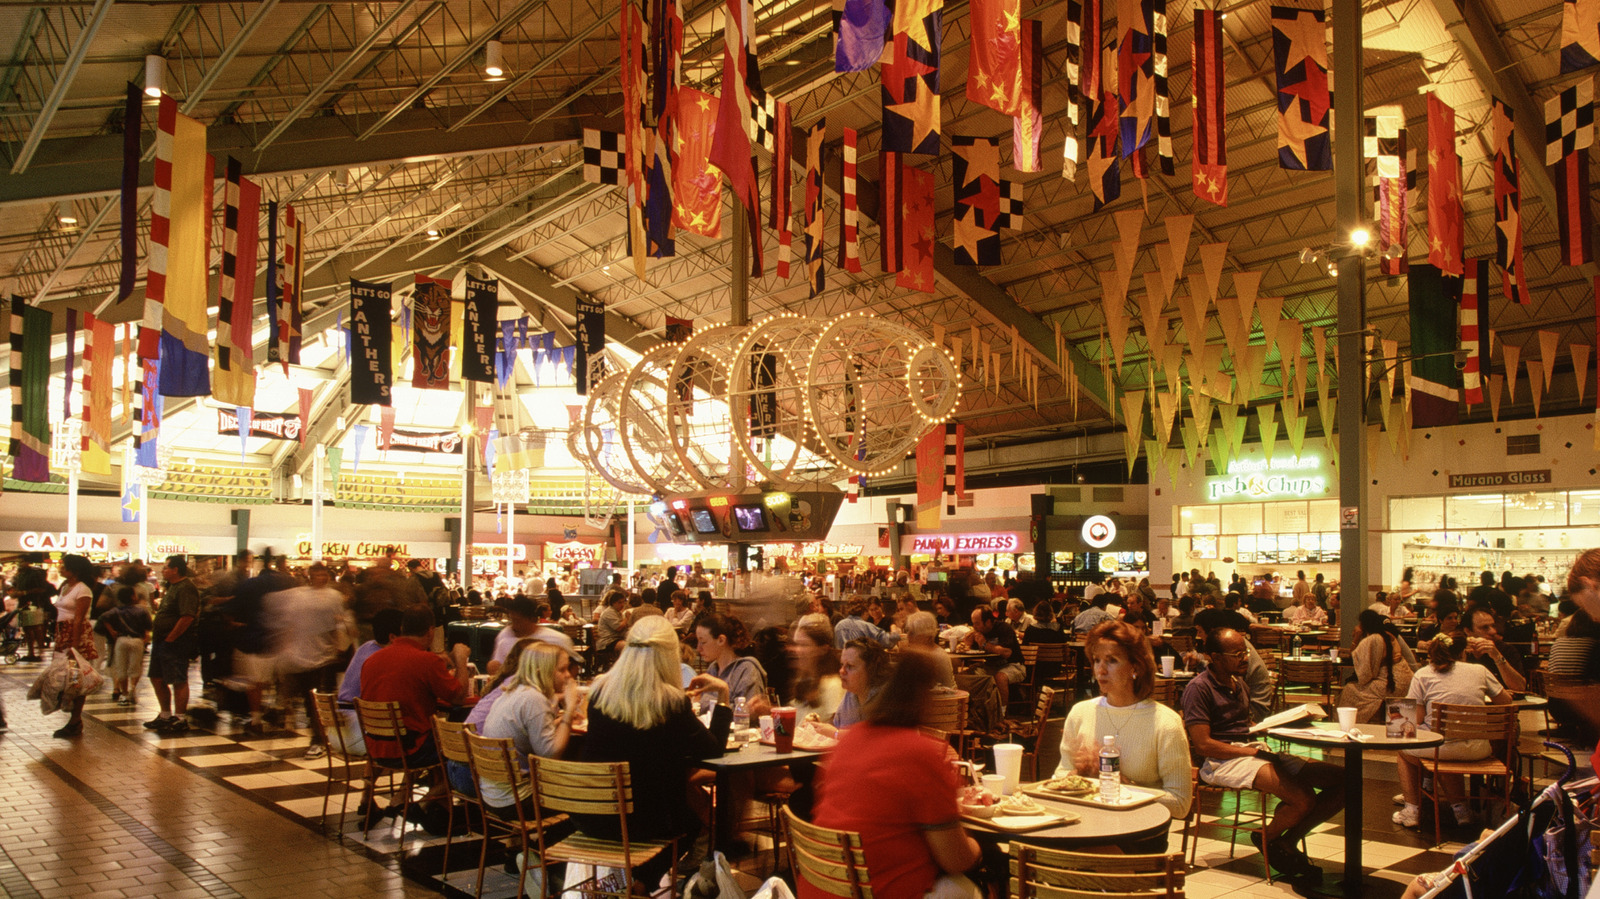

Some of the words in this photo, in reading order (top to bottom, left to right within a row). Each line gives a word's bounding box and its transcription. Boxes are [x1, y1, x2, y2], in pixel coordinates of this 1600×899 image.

[351, 286, 375, 297] LET'S
[377, 289, 391, 300] GO
[466, 280, 485, 290] LET'S
[487, 284, 497, 293] GO
[577, 304, 594, 313] LET'S
[594, 306, 604, 314] GO
[466, 290, 493, 376] PANTHERS
[353, 298, 390, 397] PANTHERS
[1210, 477, 1248, 498] Fish
[1248, 475, 1269, 496] &
[1267, 477, 1325, 494] Chips
[1452, 475, 1504, 487] Murano
[1508, 472, 1546, 483] Glass
[23, 534, 105, 549] CAJUN
[119, 537, 129, 548] &
[157, 544, 188, 554] GRILL
[298, 541, 350, 556] CHCKEN
[955, 535, 1014, 549] EXPRESS
[553, 547, 596, 560] JAPAN
